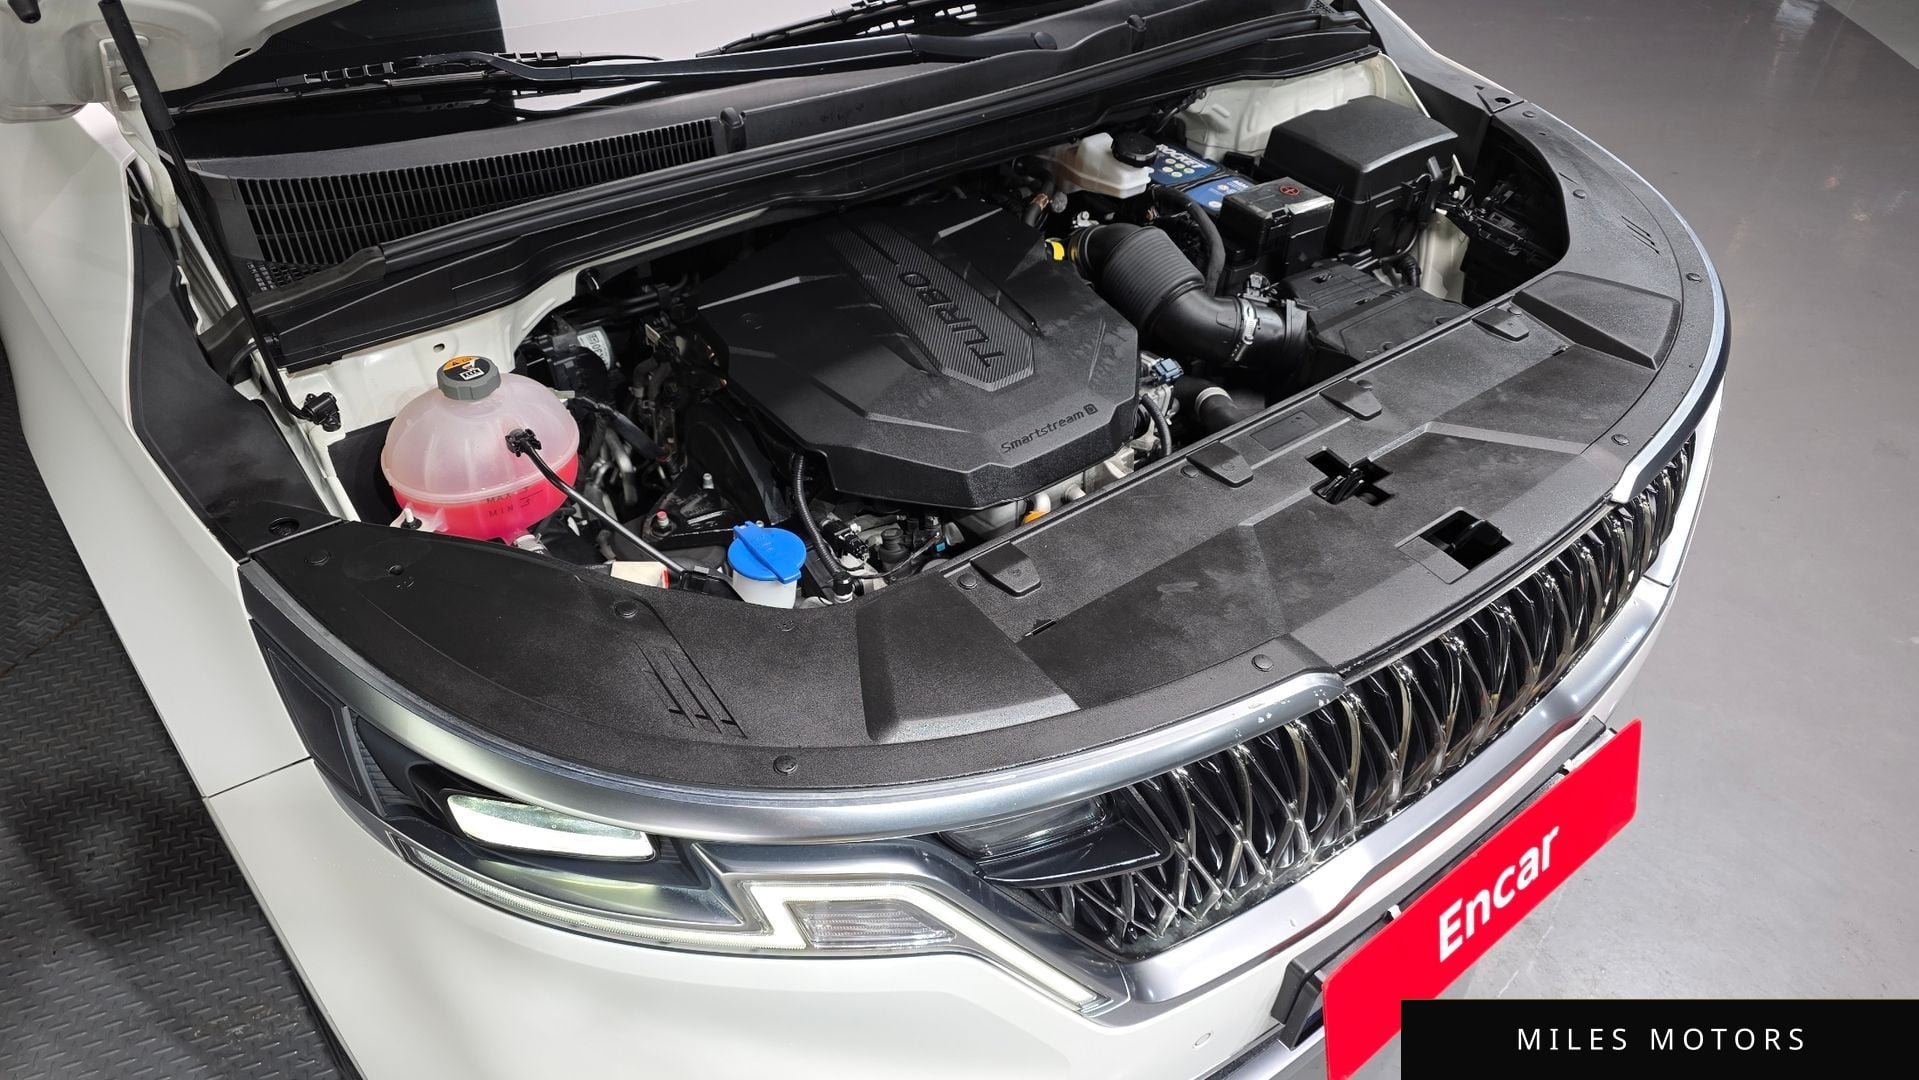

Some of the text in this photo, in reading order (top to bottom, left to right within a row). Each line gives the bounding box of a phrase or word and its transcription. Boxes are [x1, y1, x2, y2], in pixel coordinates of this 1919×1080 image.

[1156, 144, 1207, 168] ROCKET
[900, 273, 1004, 368] TURBO
[1001, 411, 1084, 453] Smartstream
[489, 505, 513, 517] MIN
[1440, 826, 1559, 963] Encar
